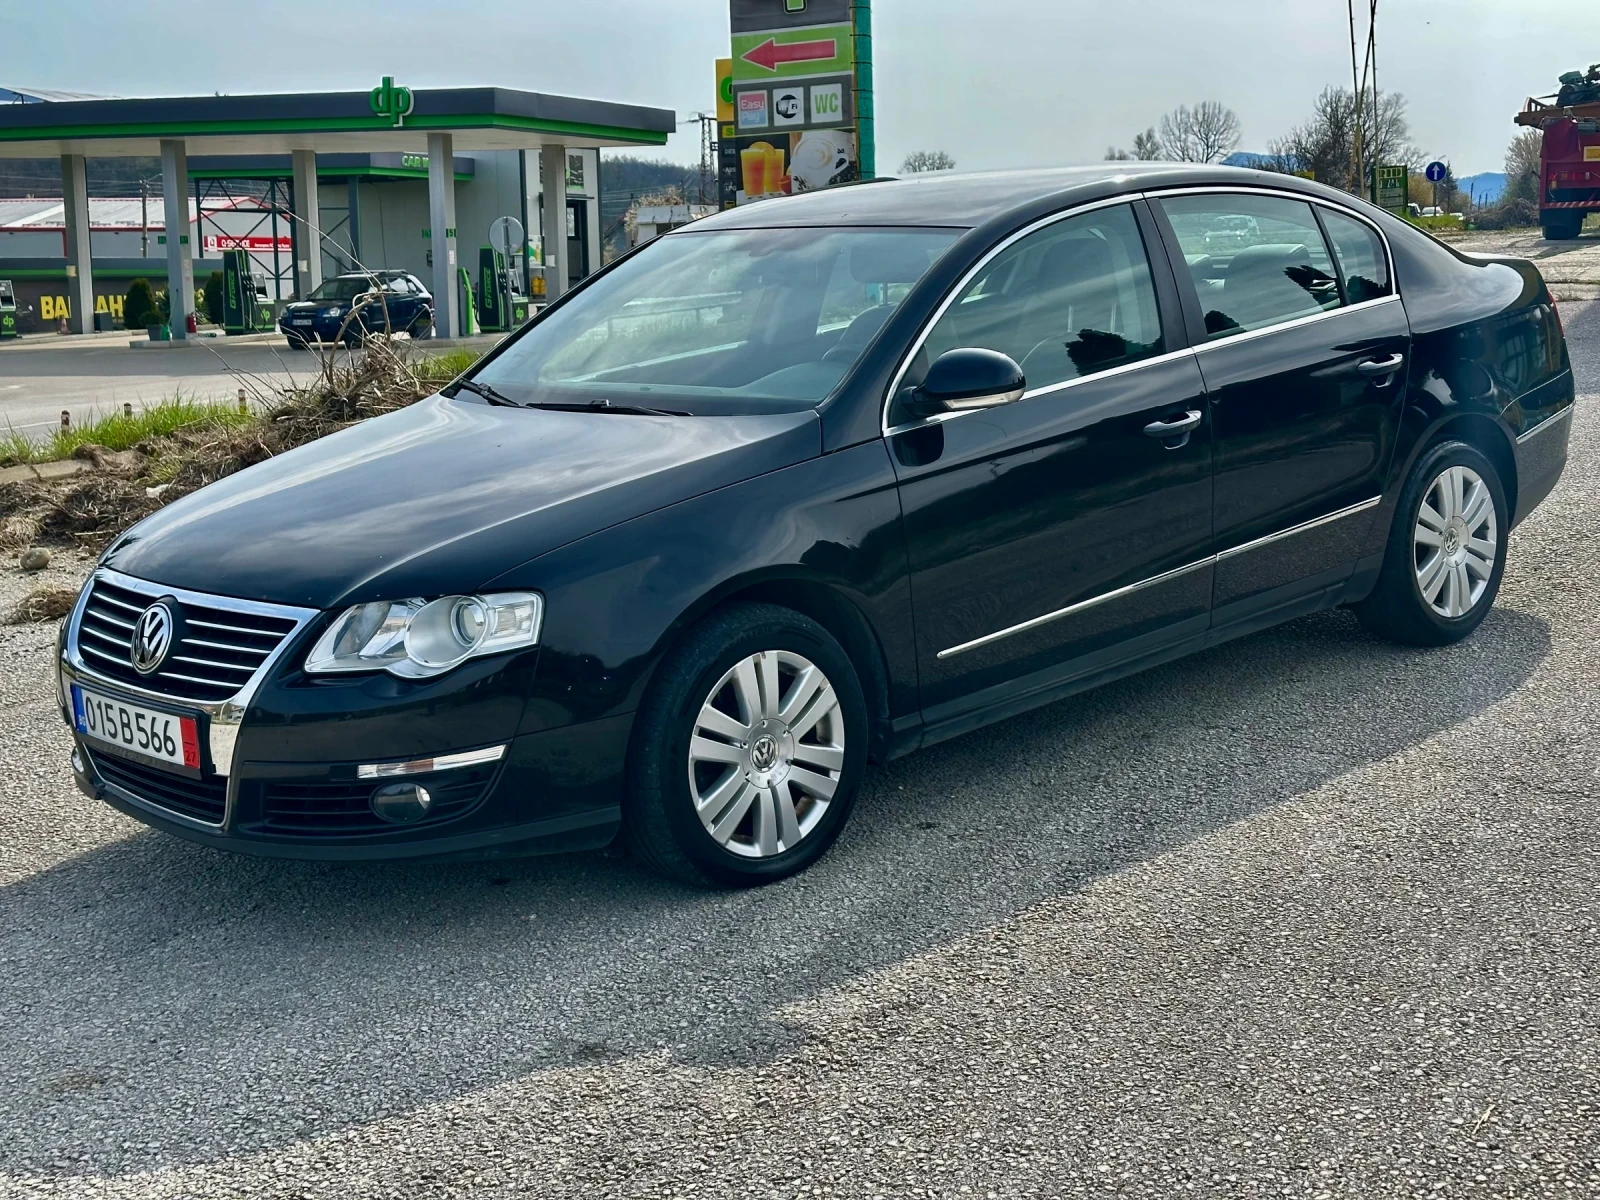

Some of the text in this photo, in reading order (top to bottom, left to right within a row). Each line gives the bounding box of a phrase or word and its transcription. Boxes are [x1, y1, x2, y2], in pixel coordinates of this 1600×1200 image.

[370, 76, 412, 127] dp
[741, 100, 764, 110] Easy
[814, 93, 838, 114] WC
[742, 112, 761, 122] Pay
[402, 156, 421, 168] CAR
